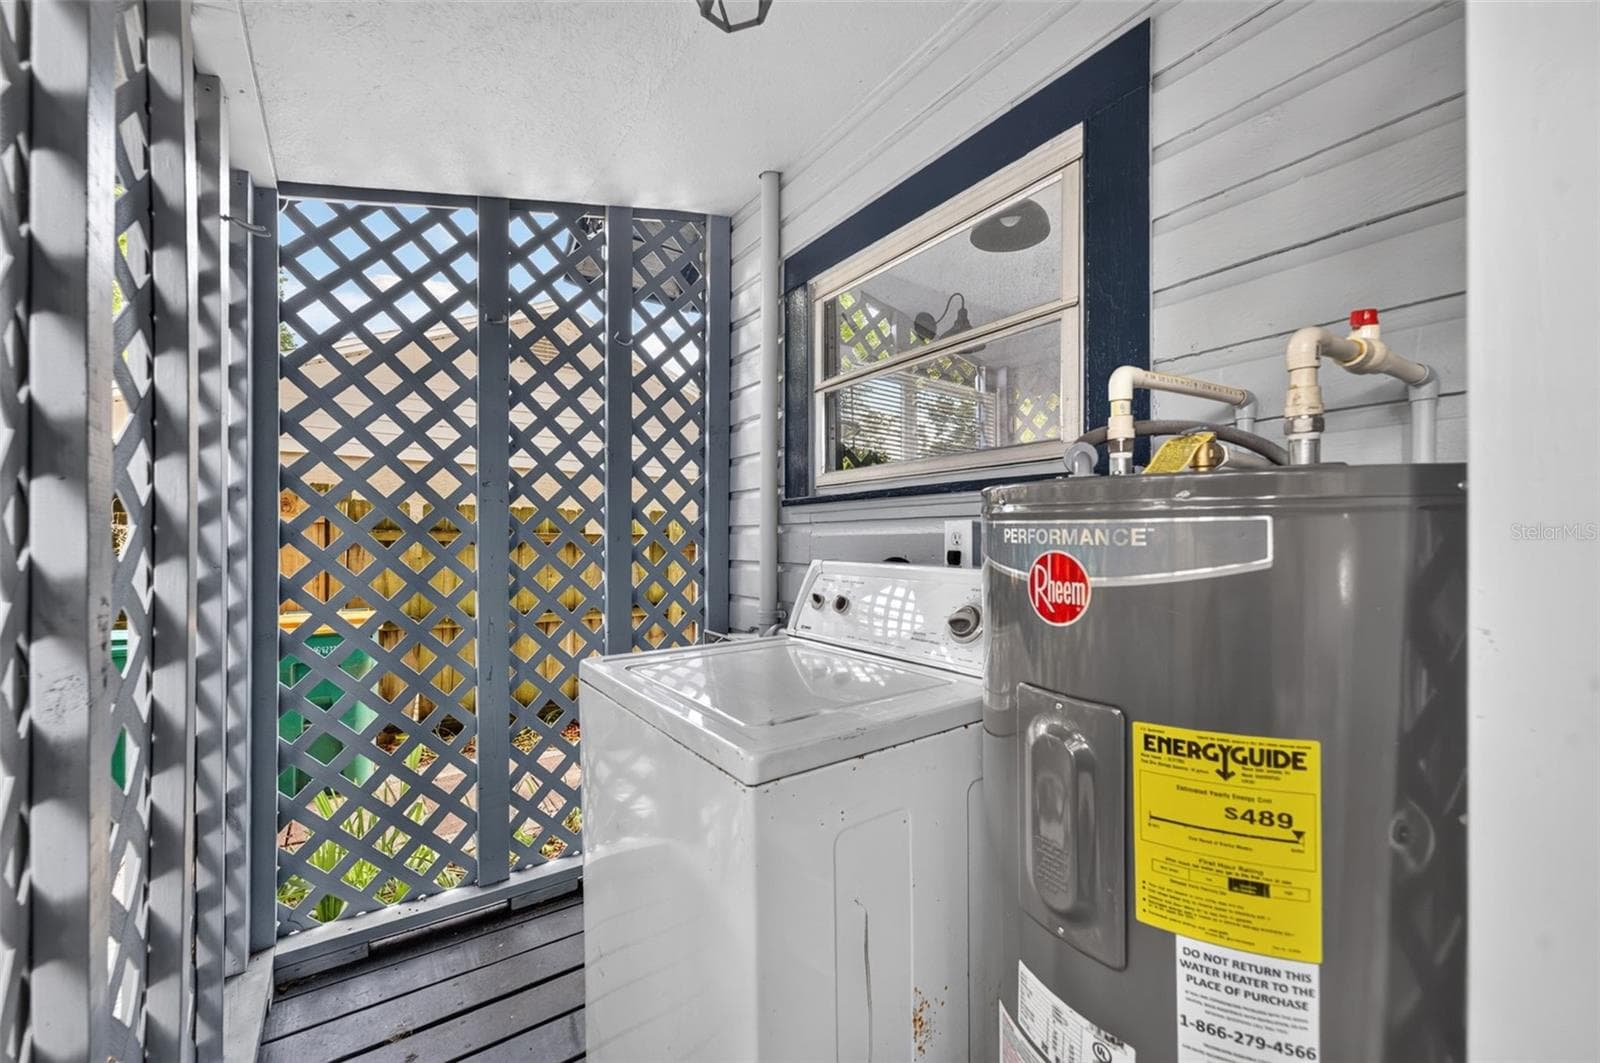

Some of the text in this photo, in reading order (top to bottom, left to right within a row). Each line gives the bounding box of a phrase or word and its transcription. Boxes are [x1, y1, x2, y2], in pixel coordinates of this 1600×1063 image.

[1003, 528, 1147, 546] PERFORMANCE
[1034, 554, 1086, 613] Rheem
[1143, 733, 1308, 772] ENERGYGUIDE
[1179, 958, 1316, 998] WATER HEATER TO THE
[1182, 946, 1312, 983] DO NOT RETURN THIS
[1185, 974, 1221, 992] PLACE
[1224, 985, 1241, 996] OF
[1243, 990, 1309, 1011] PURCHASE
[1179, 1014, 1317, 1061] 1-866-279-4566
